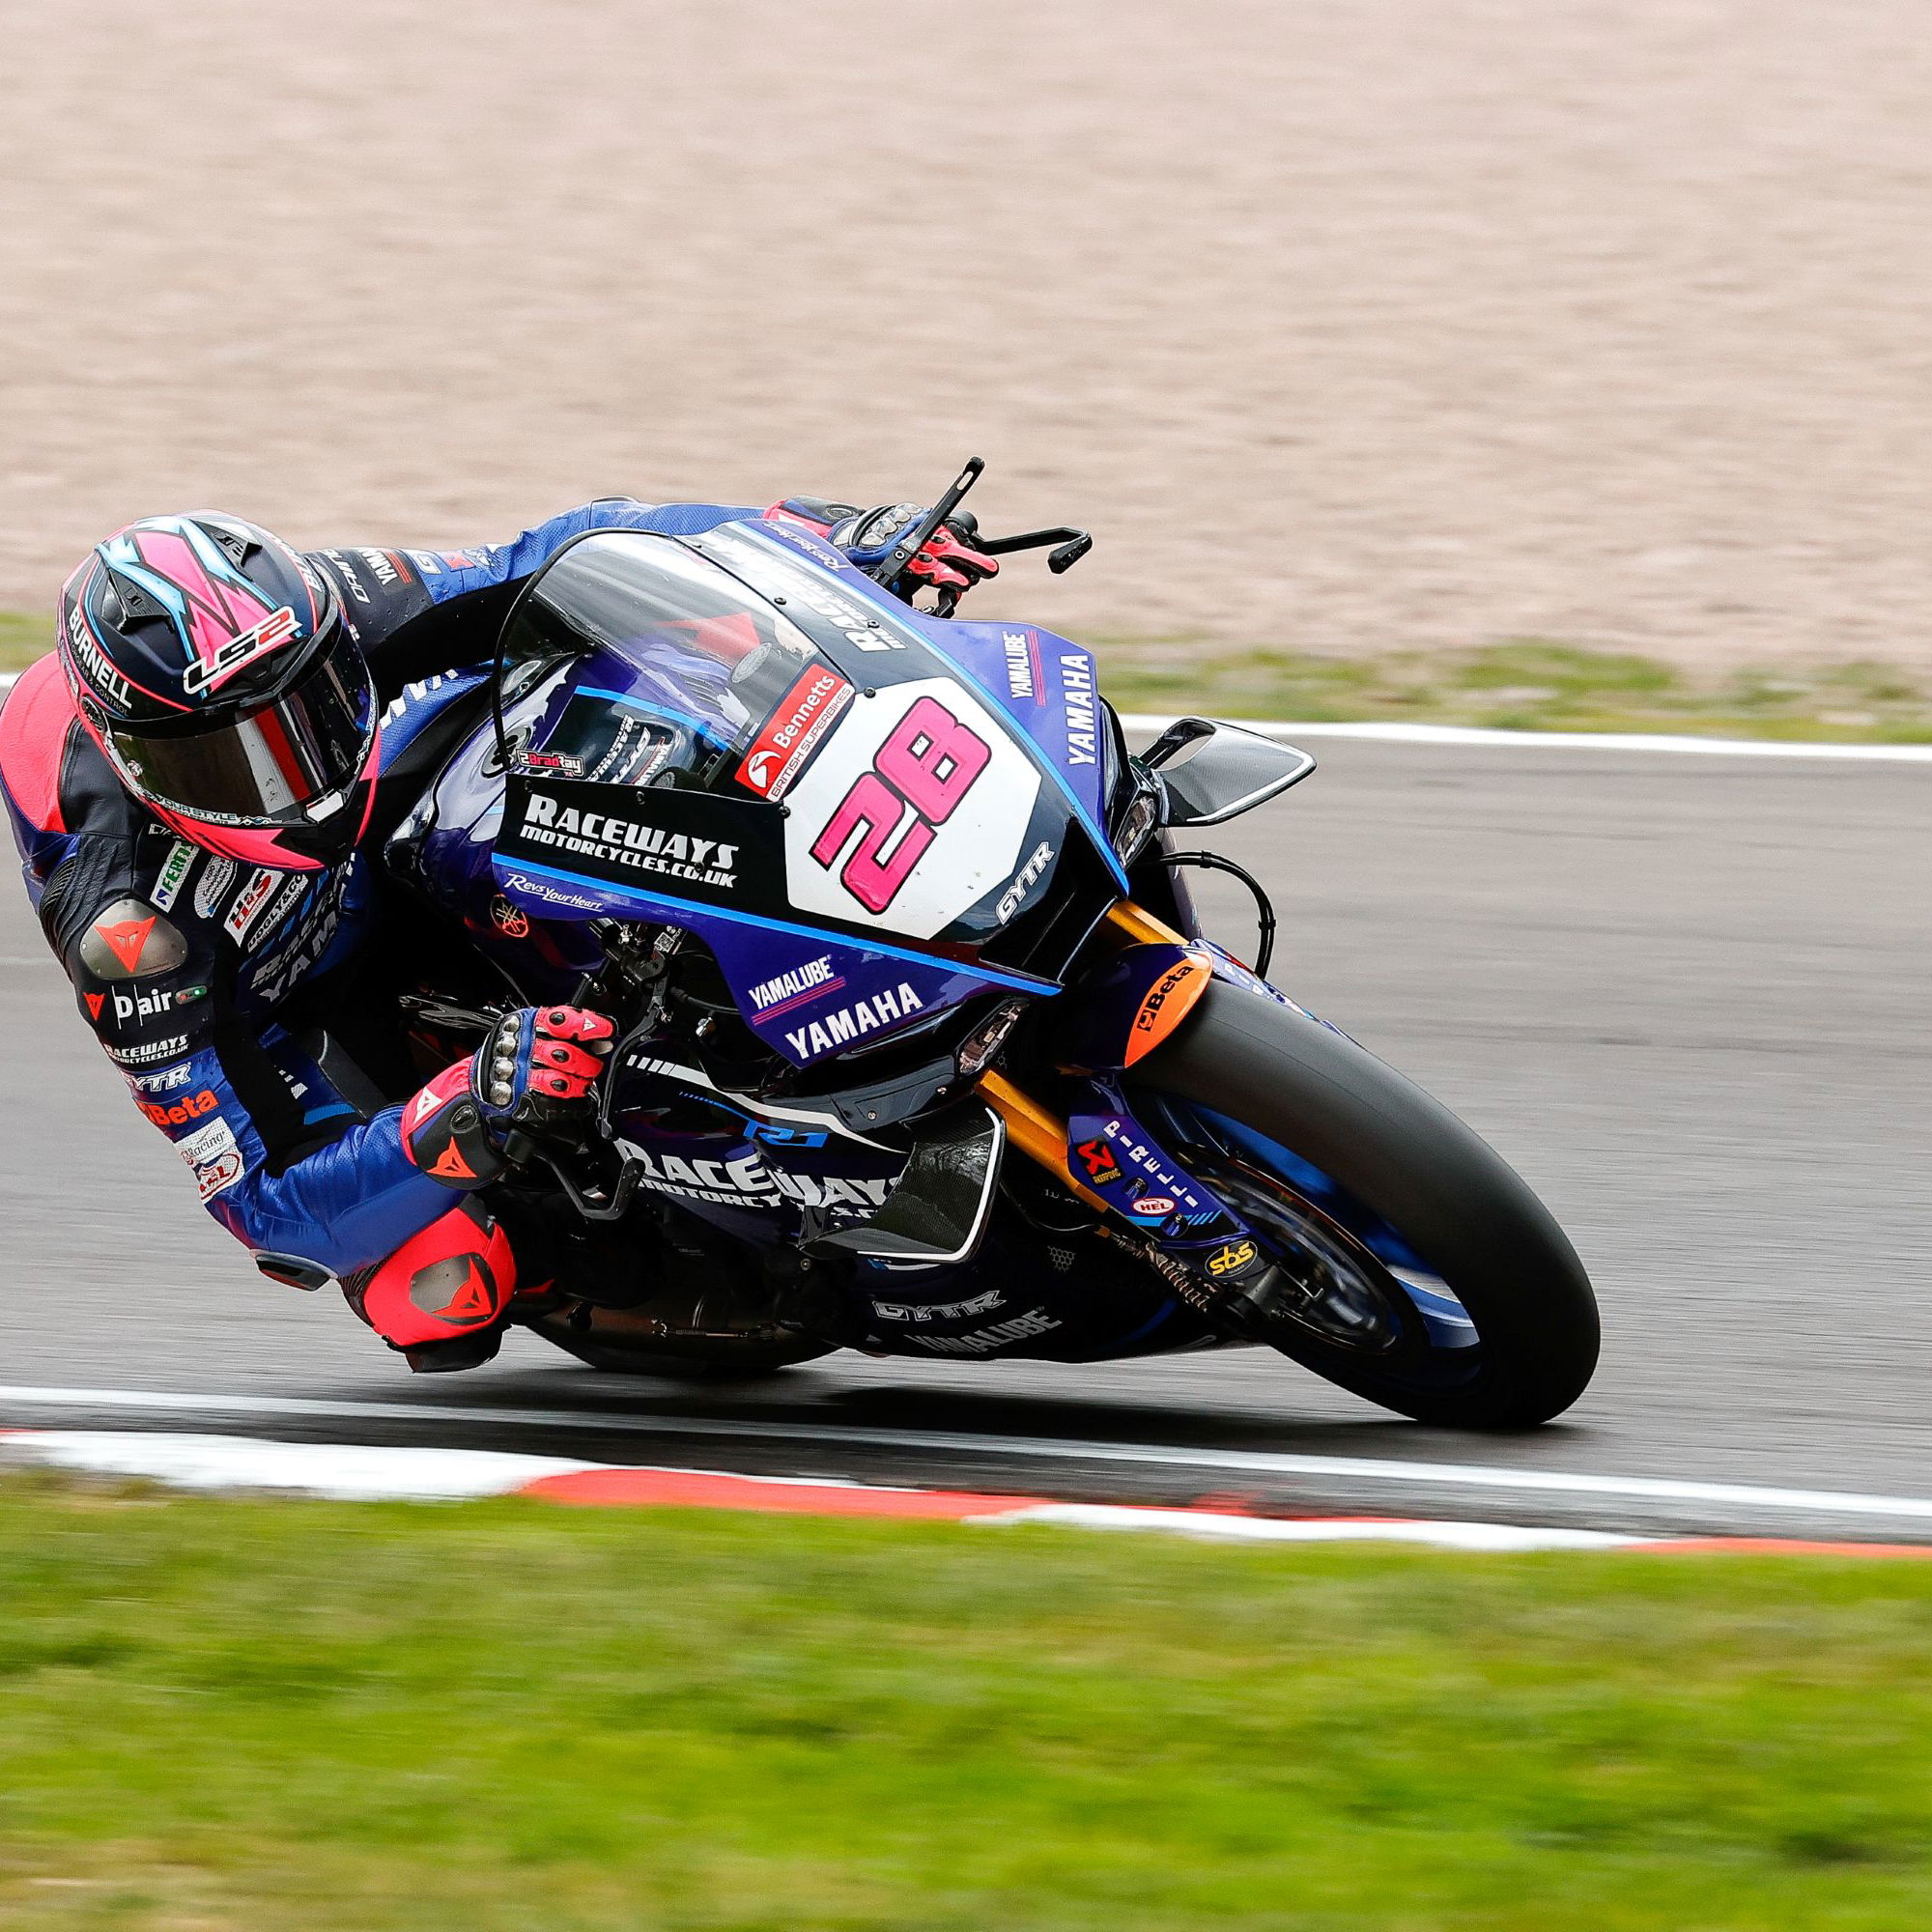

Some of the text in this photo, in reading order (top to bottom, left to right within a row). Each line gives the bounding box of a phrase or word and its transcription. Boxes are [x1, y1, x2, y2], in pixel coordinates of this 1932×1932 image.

[69, 602, 132, 709] BURNELL
[184, 606, 302, 695] LS2
[1003, 633, 1034, 698] YAMALUBE
[95, 683, 128, 716] CONTROL
[772, 674, 837, 750] Bennetts
[1060, 655, 1096, 765] YAMAHA
[634, 744, 672, 785] YAMALUB
[771, 687, 852, 800] BRITISH SUPERBIKES
[525, 793, 739, 869] RACEWAYS
[809, 696, 992, 916] 28
[519, 823, 738, 889] MOTORCYCLES.CO.UK
[995, 841, 1056, 924] GYTR
[229, 869, 272, 929] H&S
[504, 873, 605, 912] Revs Your Heart
[748, 955, 835, 1009] YAMALUBE
[1147, 965, 1195, 1011] Beta
[103, 1034, 188, 1058] RACEWAYS
[784, 981, 923, 1060] YAMAHA
[153, 1089, 220, 1125] Beta
[612, 1136, 902, 1208] RACEWAY
[1103, 1120, 1199, 1208] PIRELLI
[1140, 1201, 1170, 1211] HEL
[872, 1290, 1008, 1321] GYTR
[904, 1309, 1063, 1352] YAMALUBE
